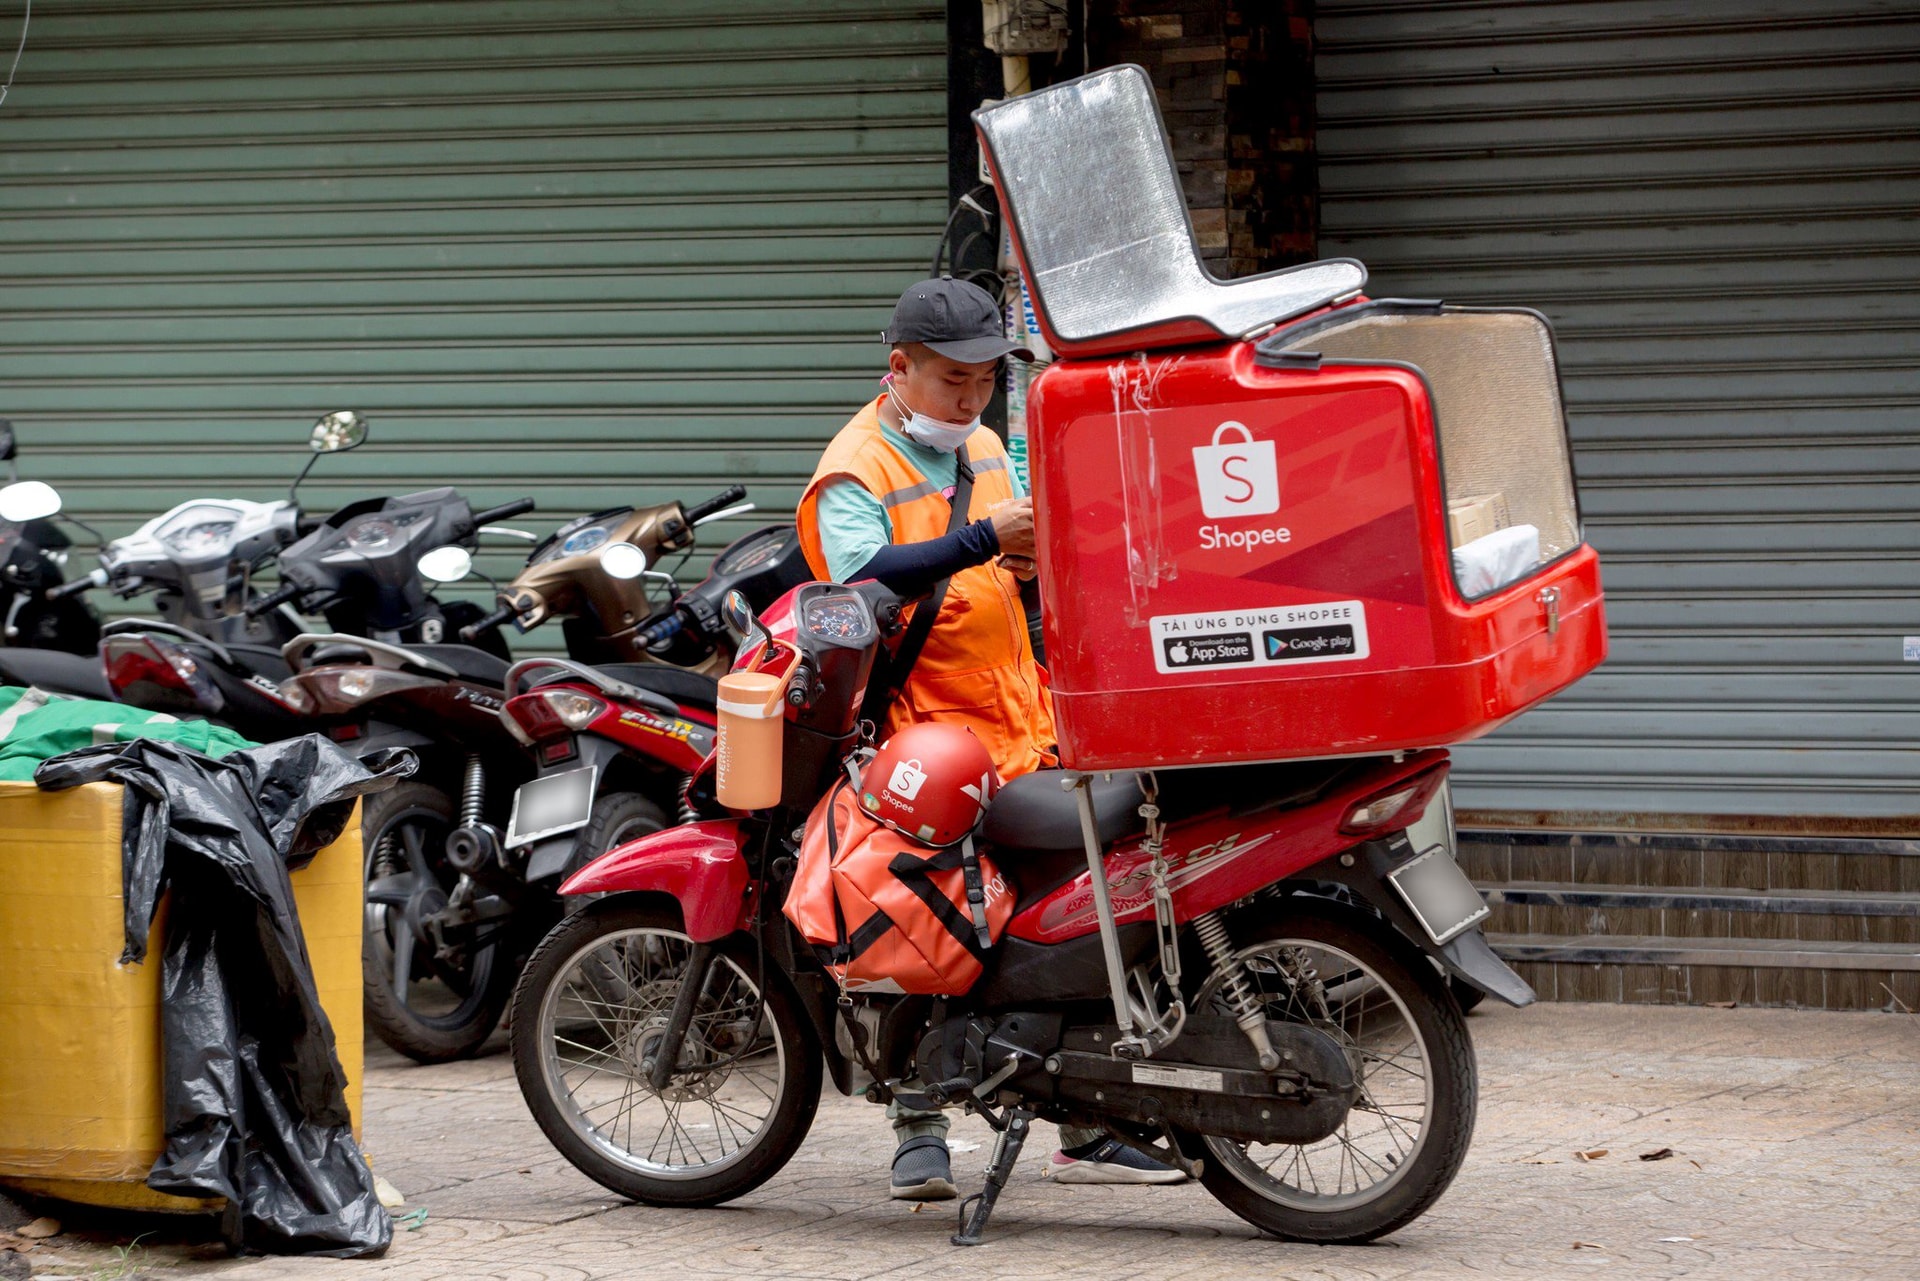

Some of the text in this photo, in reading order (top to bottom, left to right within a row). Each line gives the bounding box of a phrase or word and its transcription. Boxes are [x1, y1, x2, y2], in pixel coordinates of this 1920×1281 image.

[1198, 525, 1291, 553] Shopee
[1236, 613, 1279, 628] DỤNG
[1288, 608, 1351, 623] SHOPEE
[1189, 638, 1224, 648] Download
[1191, 643, 1249, 661] App Store
[1289, 634, 1352, 651] Google play
[718, 723, 728, 791] THERMAL
[881, 789, 914, 813] Shopee
